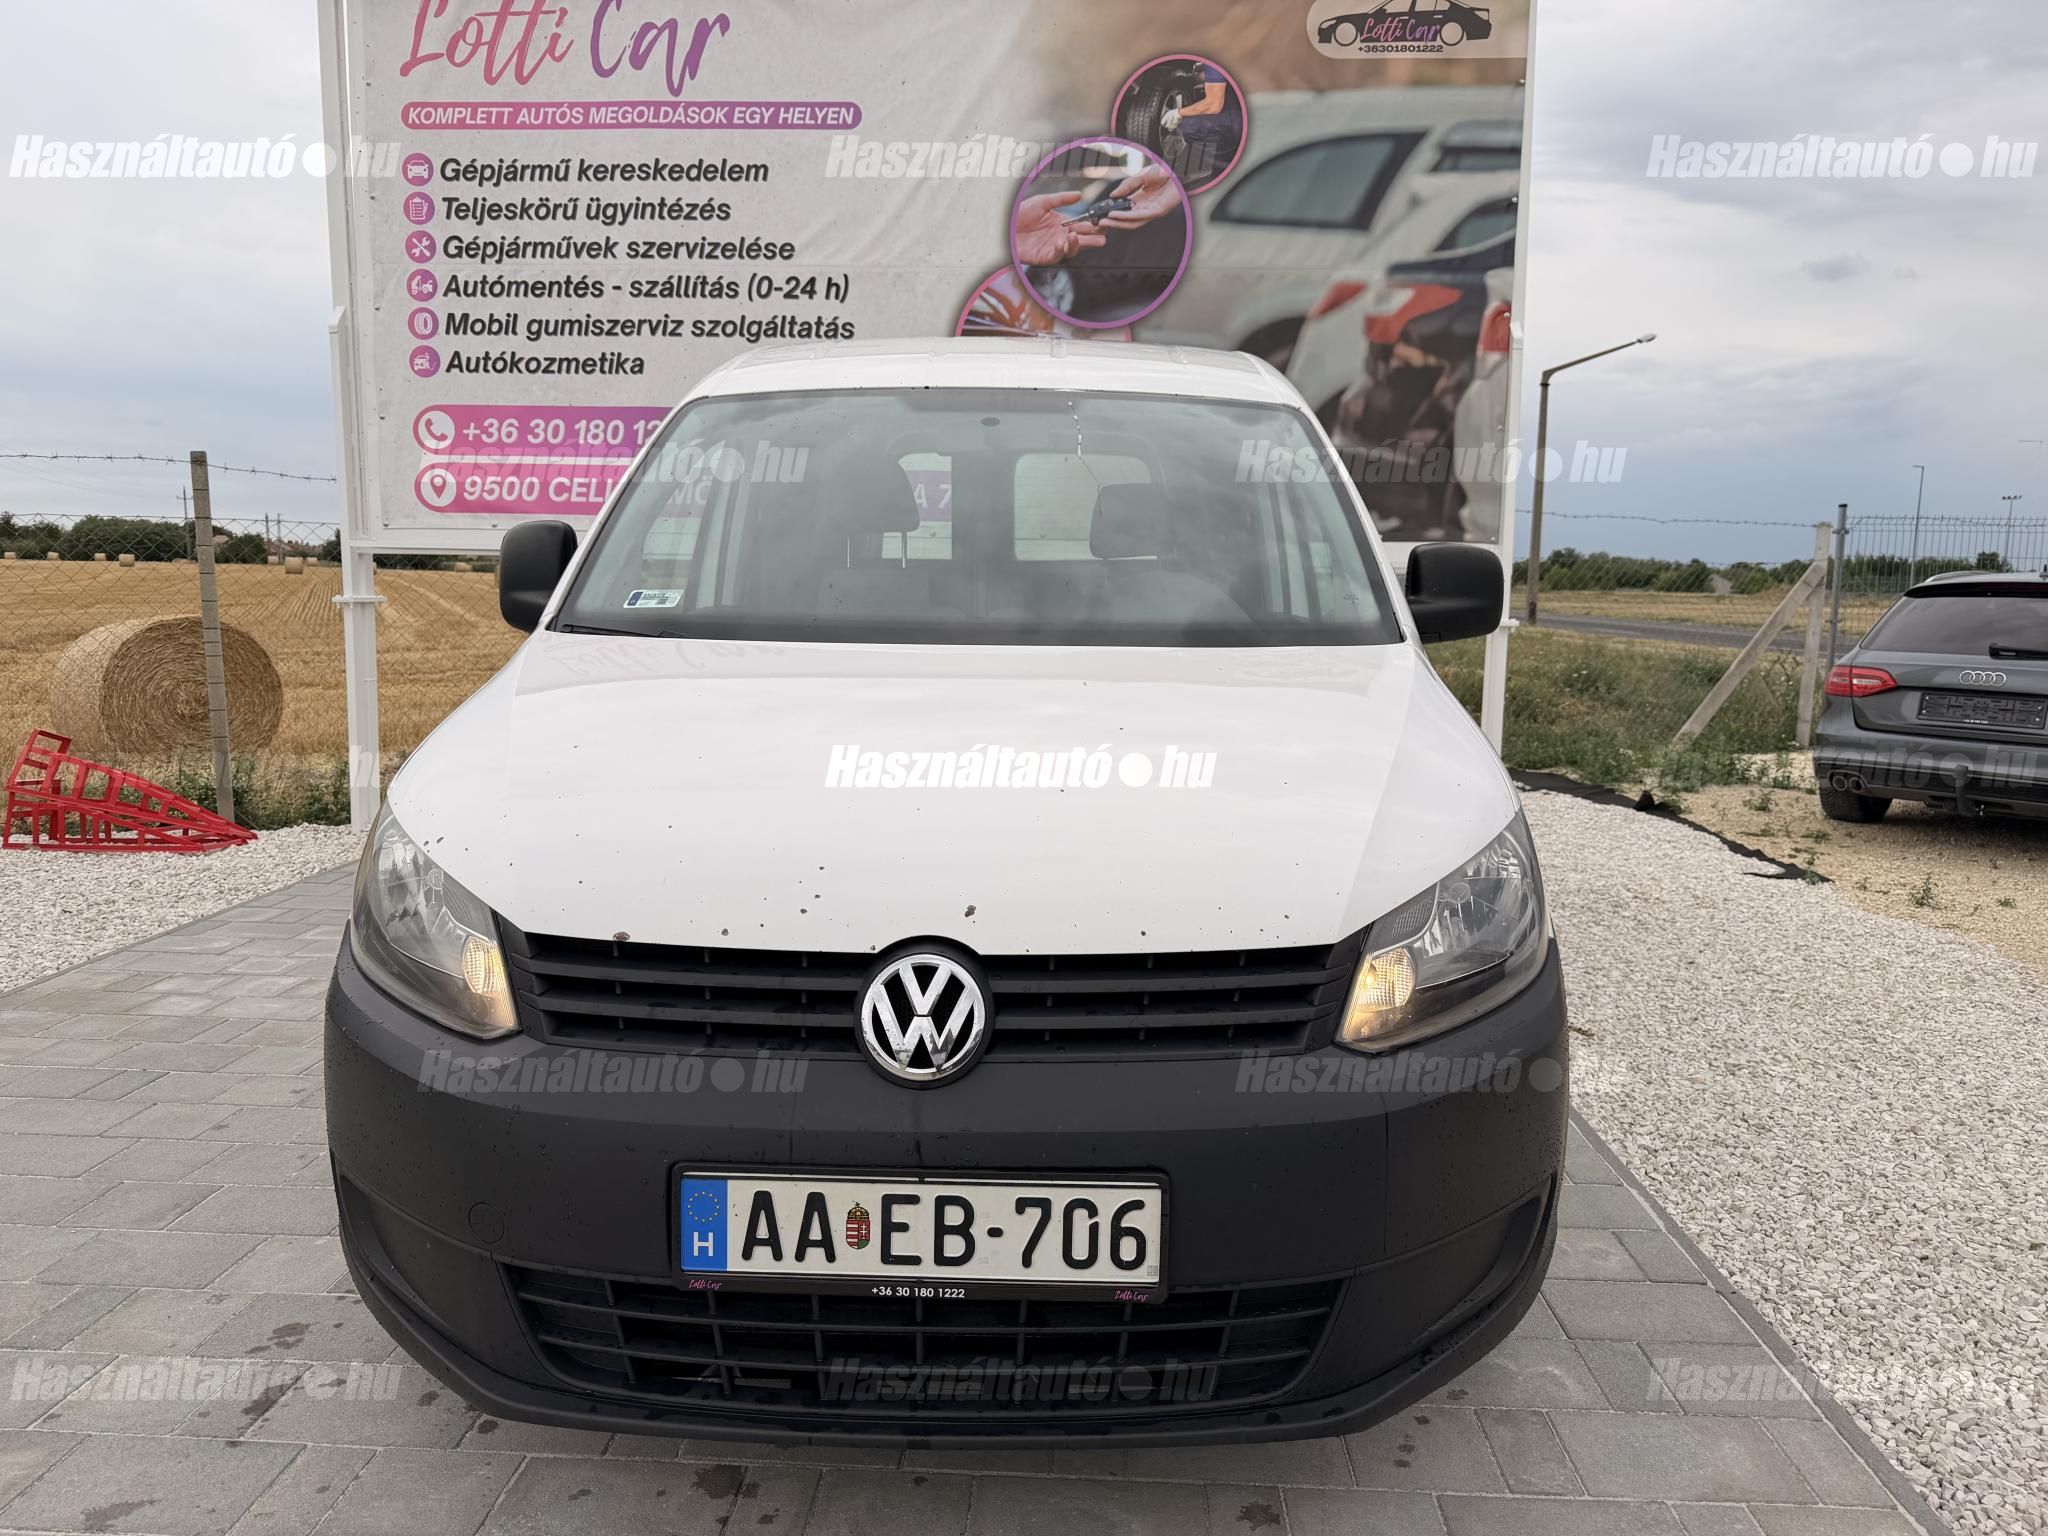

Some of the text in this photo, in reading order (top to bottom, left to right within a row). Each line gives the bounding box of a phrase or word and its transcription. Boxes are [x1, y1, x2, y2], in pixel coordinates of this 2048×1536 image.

[1360, 17, 1441, 43] Lotti Car
[400, 0, 731, 97] Lotti Car
[1358, 44, 1443, 53] +36301801222
[407, 103, 855, 125] KOMPLETT AUTÓS MEGOLDÁSOK EGY HELYEN
[440, 157, 769, 187] Gépjármű kereskedelem
[442, 196, 732, 226] Teljeskörű ügyintézés
[443, 235, 796, 265] Gépjárművek szervizelése
[442, 274, 605, 299] Autómentés
[628, 274, 740, 299] szállítás
[747, 272, 818, 302] (0-24
[824, 273, 850, 303] h)
[445, 312, 856, 343] Mobil gumiszerviz szolgáltatás
[445, 350, 646, 376] Autókozmetika
[462, 417, 663, 446] +36 30 180 12
[463, 475, 541, 501] 9500
[693, 1189, 1147, 1271] H AA EB-706
[872, 1286, 966, 1298] +36 30 180 1222
